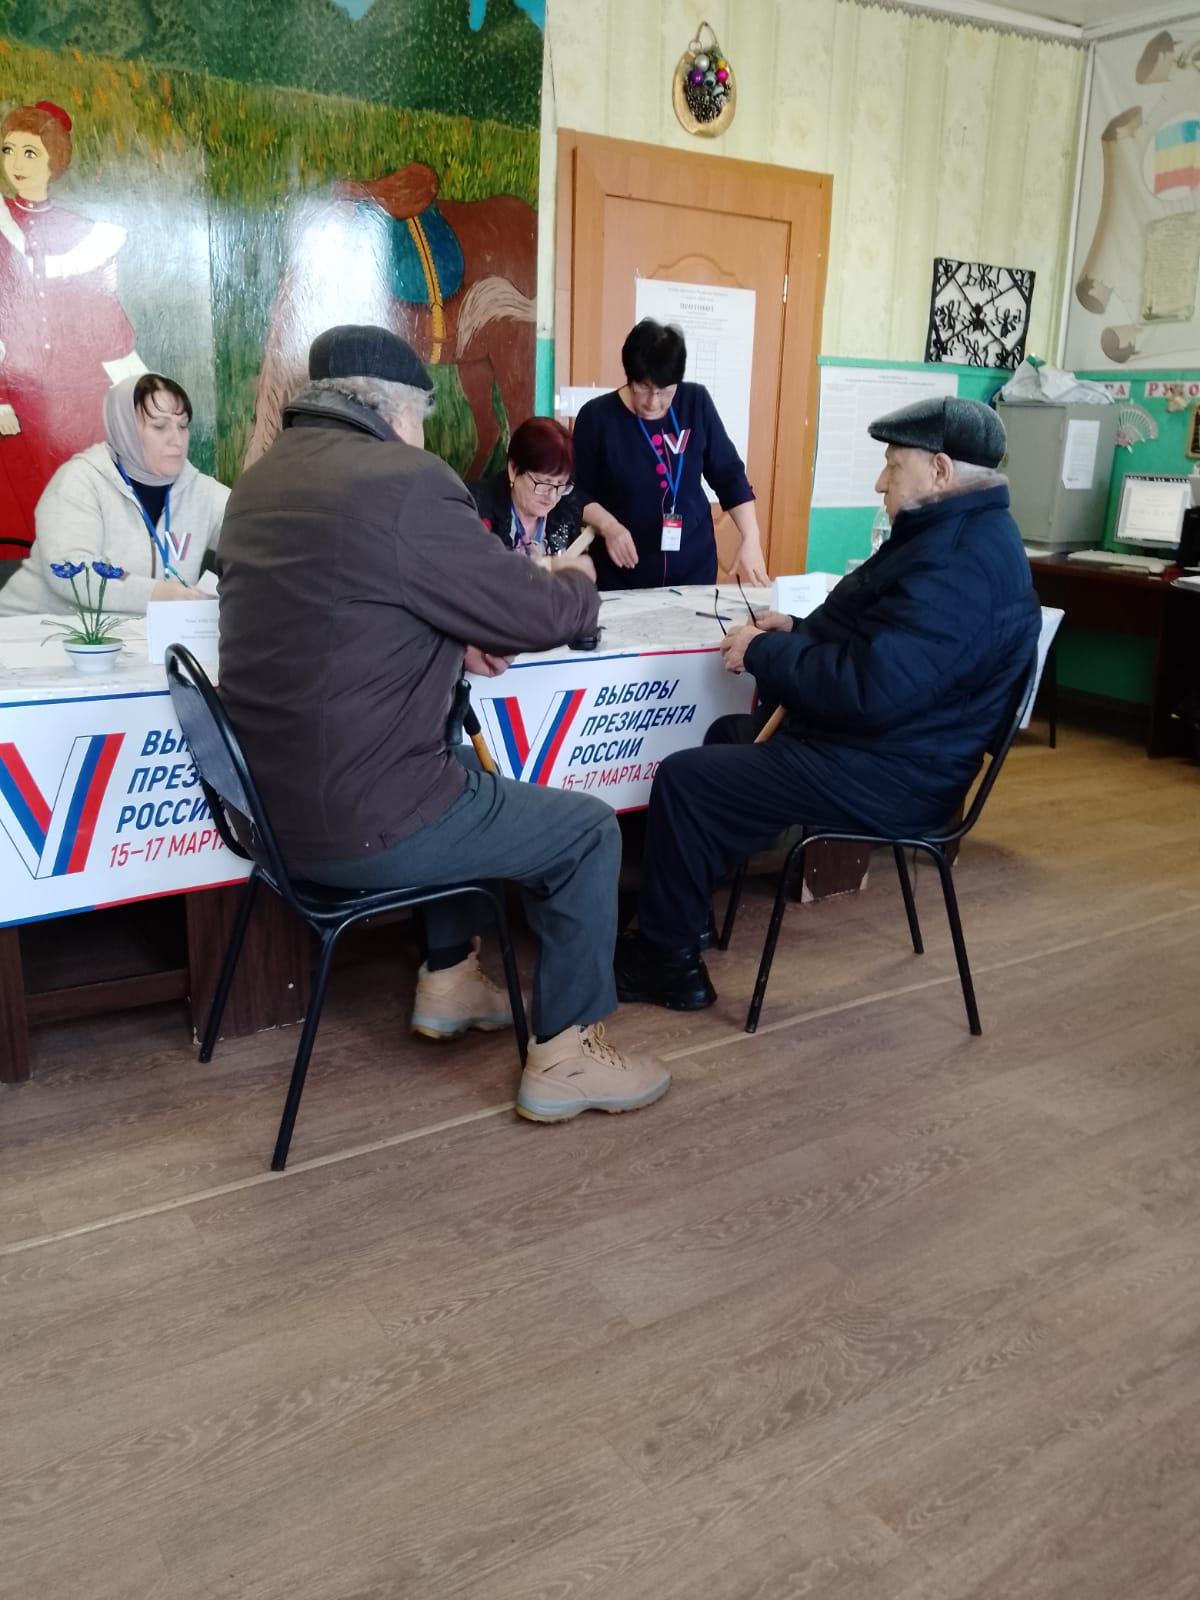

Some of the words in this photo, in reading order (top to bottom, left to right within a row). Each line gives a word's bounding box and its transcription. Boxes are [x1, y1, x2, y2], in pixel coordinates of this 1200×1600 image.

[593, 679, 680, 708] ВЫБОРЫ
[580, 704, 697, 737] ПРЕЗИДЕНТА
[140, 728, 190, 757] ВЫ
[567, 737, 645, 767] РОССИИ
[127, 762, 202, 794] ПРЕЗ
[598, 764, 642, 787] МАРТА
[642, 761, 663, 781] 20
[115, 797, 214, 834] РОССИ
